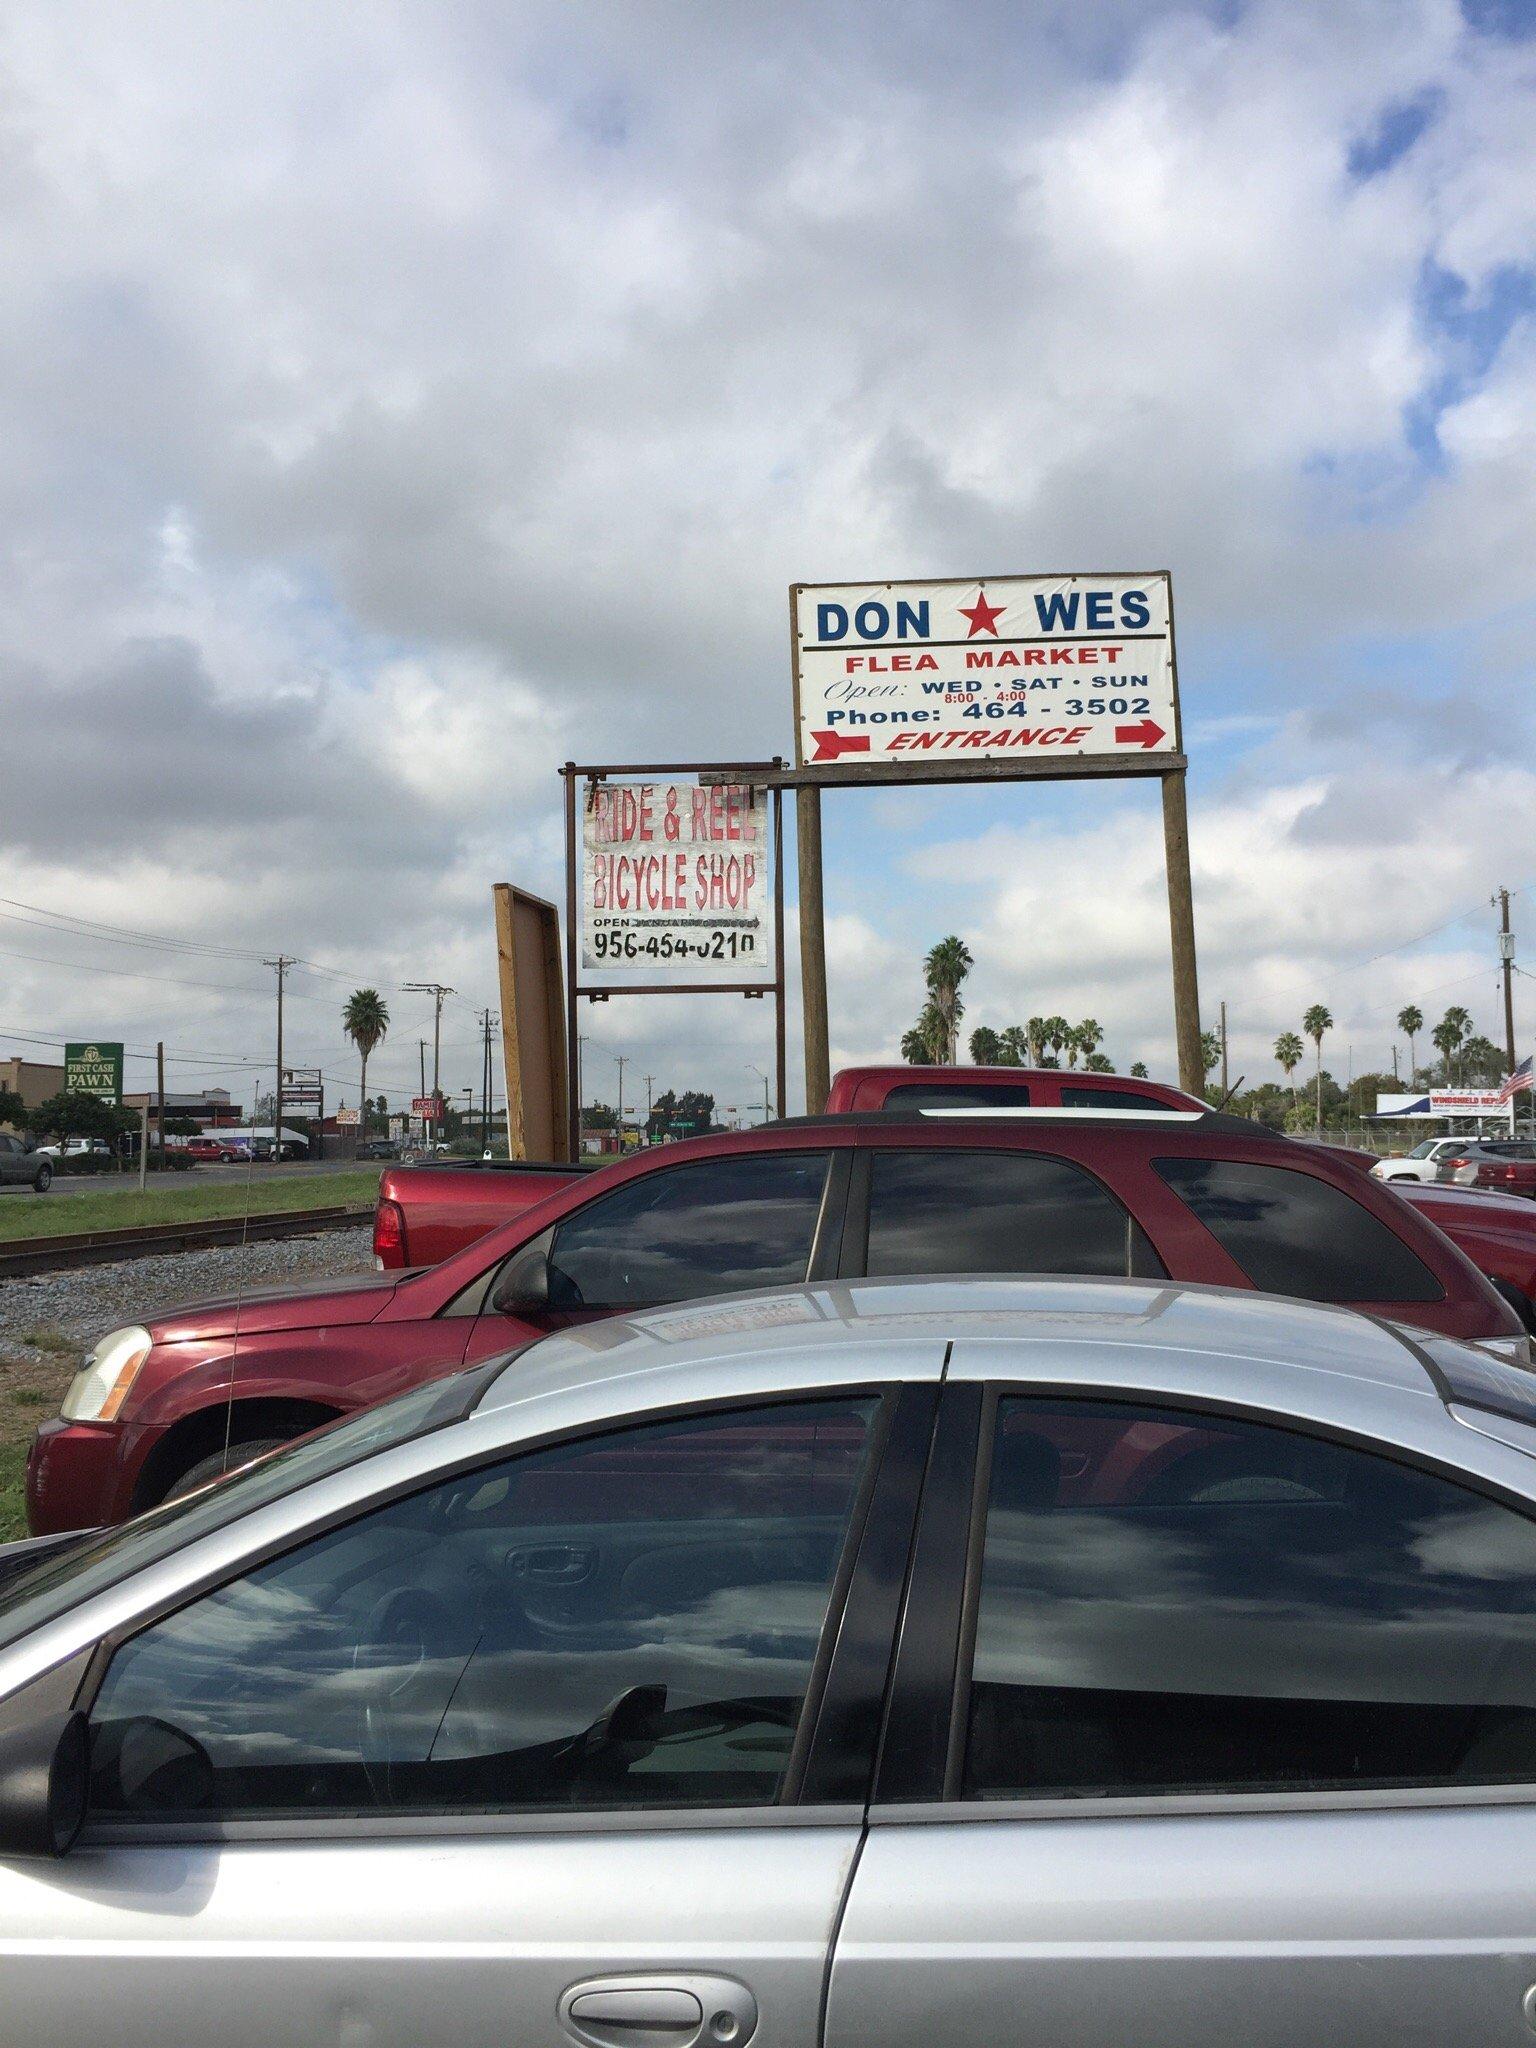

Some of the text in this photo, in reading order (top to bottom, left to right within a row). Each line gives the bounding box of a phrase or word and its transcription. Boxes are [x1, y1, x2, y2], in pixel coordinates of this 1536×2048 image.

[817, 590, 1151, 642] DON WES
[846, 647, 1124, 673] FLEA MARKET
[823, 674, 1148, 703] Open: WED SAT SUN
[944, 691, 974, 704] 8:00
[996, 690, 1026, 702] 4:00
[827, 707, 940, 726] Phone:
[962, 701, 1027, 720] 464
[1065, 698, 1151, 716] 3502
[885, 726, 1093, 751] ENTRANCE
[594, 787, 654, 842] RIDE
[664, 786, 681, 842] &
[593, 853, 756, 911] BICYCLE SHOP
[593, 918, 630, 927] OPEN
[67, 1074, 113, 1086] PAWN
[68, 1063, 115, 1073] FIRST CASH
[1432, 1096, 1508, 1105] WINDSHIELD REP
